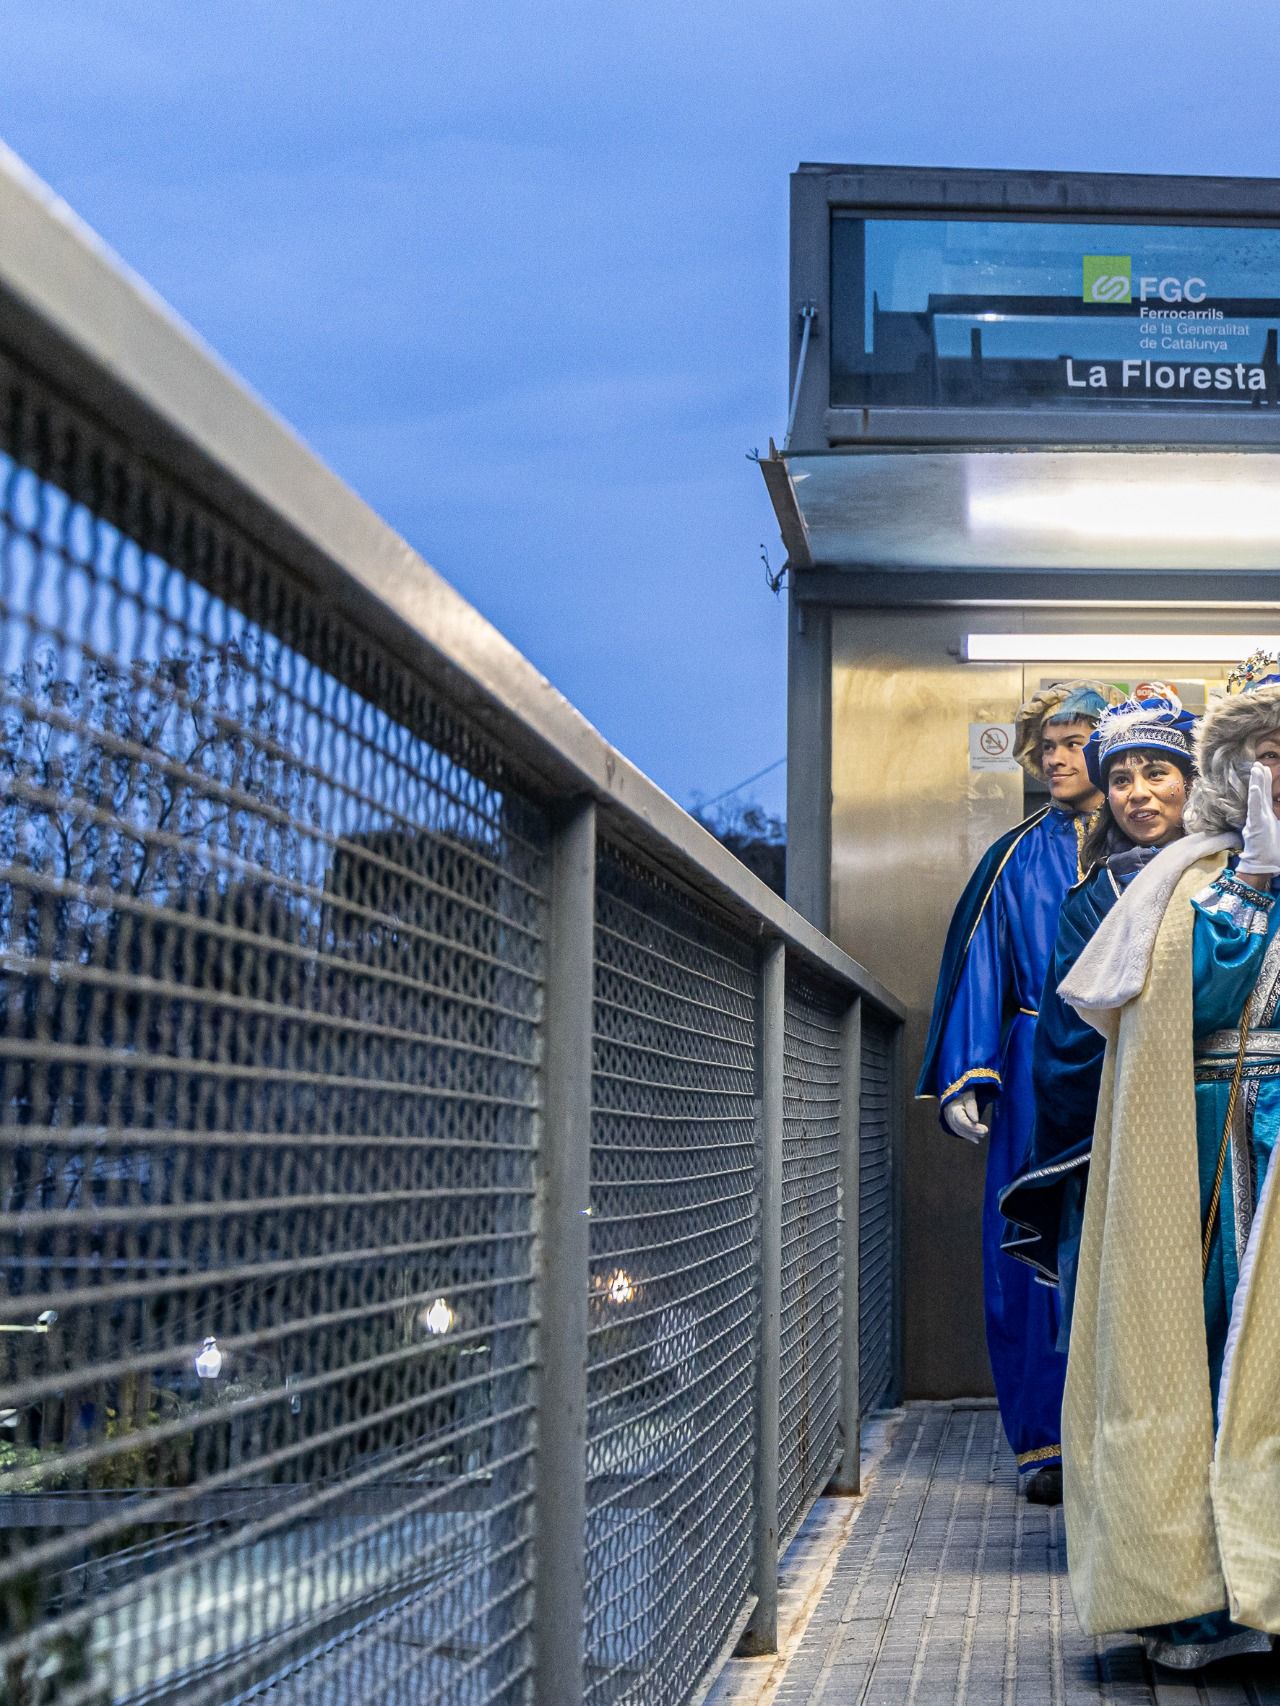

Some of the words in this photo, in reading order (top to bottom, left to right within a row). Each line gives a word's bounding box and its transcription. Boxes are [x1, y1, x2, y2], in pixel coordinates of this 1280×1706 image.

[1140, 277, 1207, 303] FGC
[1140, 307, 1224, 320] Ferrocarrils
[1140, 323, 1157, 334] de
[1161, 323, 1172, 334] la
[1177, 324, 1250, 336] Generalitat
[1140, 338, 1157, 349] de
[1161, 338, 1228, 352] Catalunya
[1066, 359, 1107, 388] La
[1122, 360, 1266, 389] Floresta
